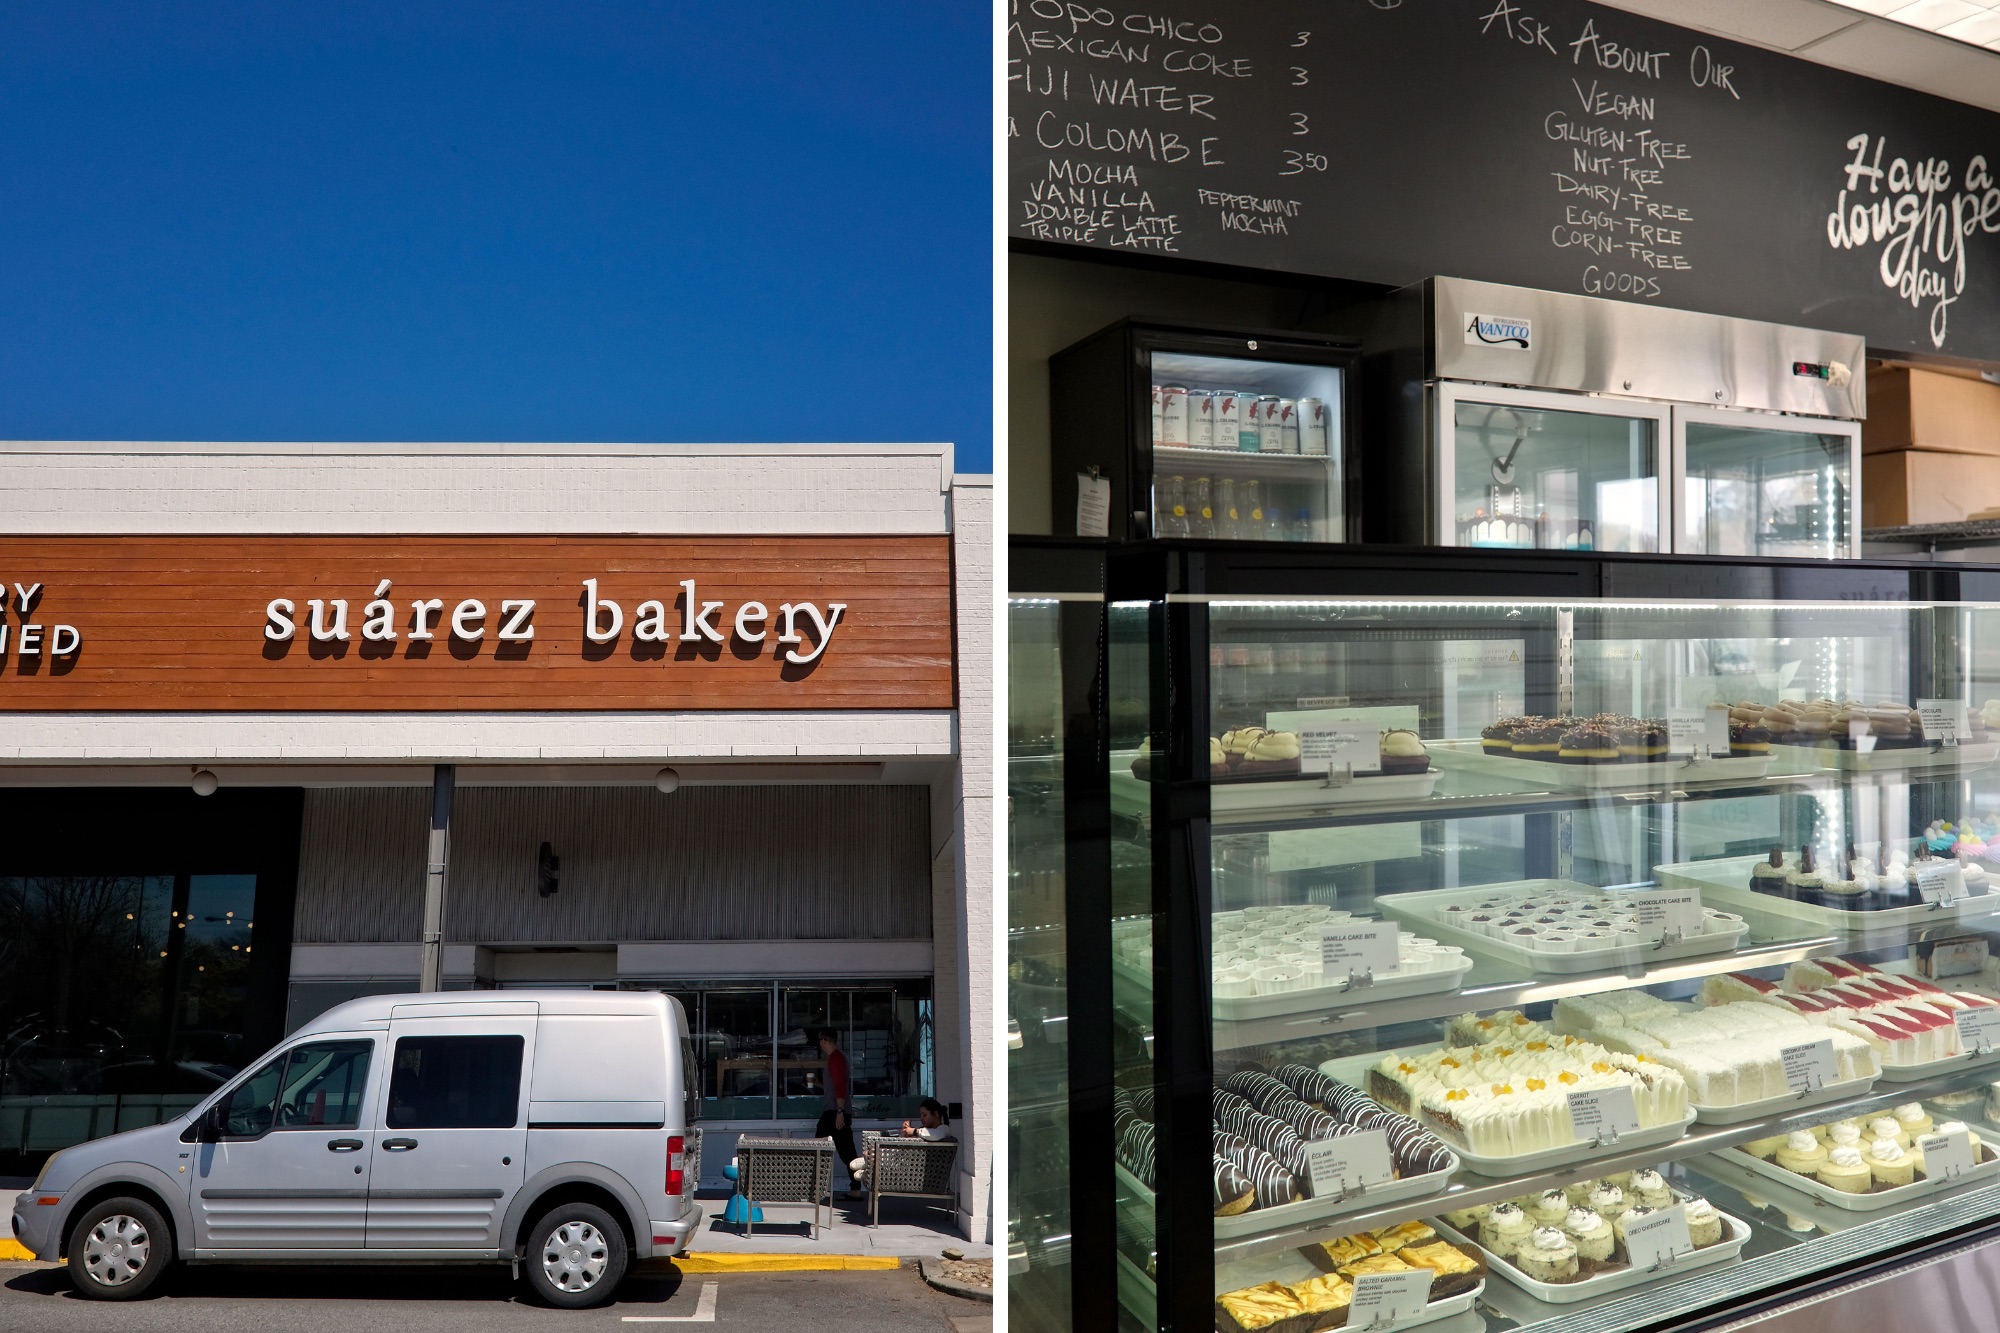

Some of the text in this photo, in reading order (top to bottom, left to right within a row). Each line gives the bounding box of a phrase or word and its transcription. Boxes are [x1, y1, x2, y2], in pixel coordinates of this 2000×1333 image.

[1123, 14, 1223, 43] CHICO
[1289, 31, 1312, 48] 3
[1163, 50, 1253, 78] COKE
[1289, 66, 1310, 86] 3
[1479, 0, 1741, 100] ASK ABOUT OUR
[1090, 73, 1217, 121] WATER
[1289, 112, 1310, 136] 3
[1572, 77, 1655, 121] VEGAN
[1036, 110, 1226, 167] COLOMBE
[1544, 110, 1692, 170] GLUTEN-FREE
[1048, 158, 1139, 187] MOCHA
[1573, 147, 1664, 192] NUT-FREE
[1844, 133, 1994, 194] Have a
[1030, 179, 1156, 213] VANILLA
[1198, 187, 1303, 218] PEPPERMINT
[1551, 171, 1694, 223] DAIRY-FREE
[1020, 220, 1180, 252] TRIPLE LATTE
[1022, 199, 1183, 236] DOUBLE LATTE
[1220, 209, 1290, 236] MOCHA
[1566, 205, 1683, 246] EGG-FREE
[1551, 225, 1693, 271] CORN-FREE
[1582, 265, 1661, 297] GOODS
[1900, 244, 1958, 350] day
[1466, 315, 1530, 344] AVANTCO
[265, 578, 847, 666] suárez bakery
[1569, 1092, 1589, 1100] CARROT
[1628, 1217, 1671, 1236] OREO CHEESECAKE
[1357, 1284, 1383, 1292] BROWNIE
